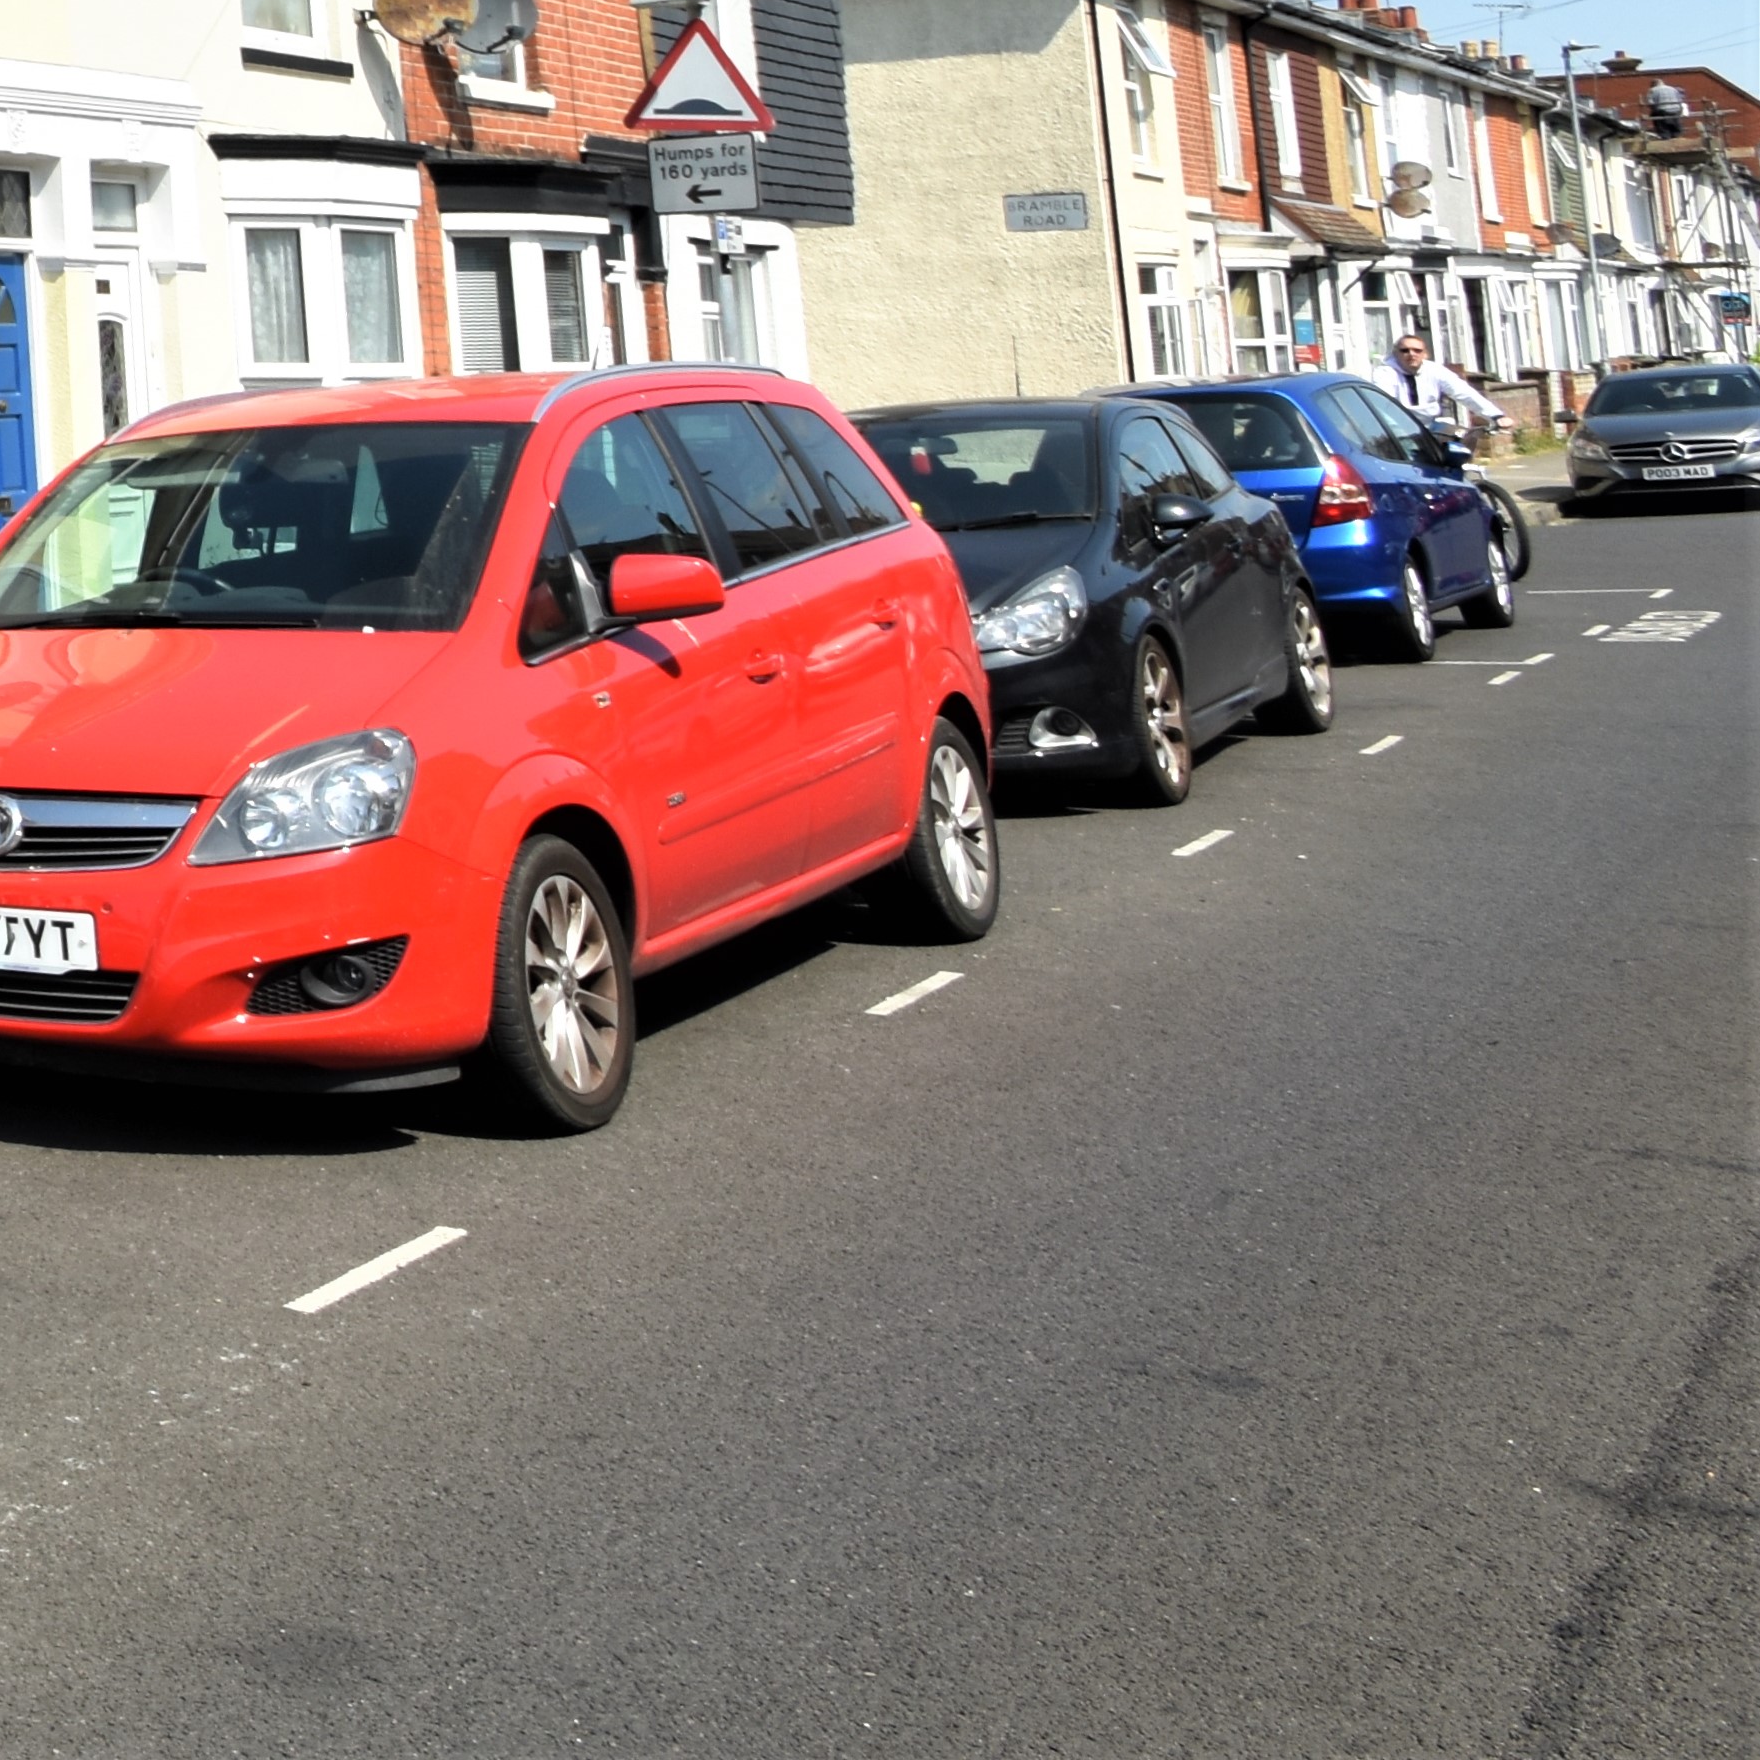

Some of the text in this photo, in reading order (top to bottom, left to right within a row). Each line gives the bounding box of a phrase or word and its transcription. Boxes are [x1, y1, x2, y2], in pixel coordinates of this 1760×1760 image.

[654, 143, 746, 161] Humps for
[660, 162, 747, 180] 160 yards
[1007, 199, 1081, 212] BRAMBLE
[1023, 215, 1067, 226] ROAD
